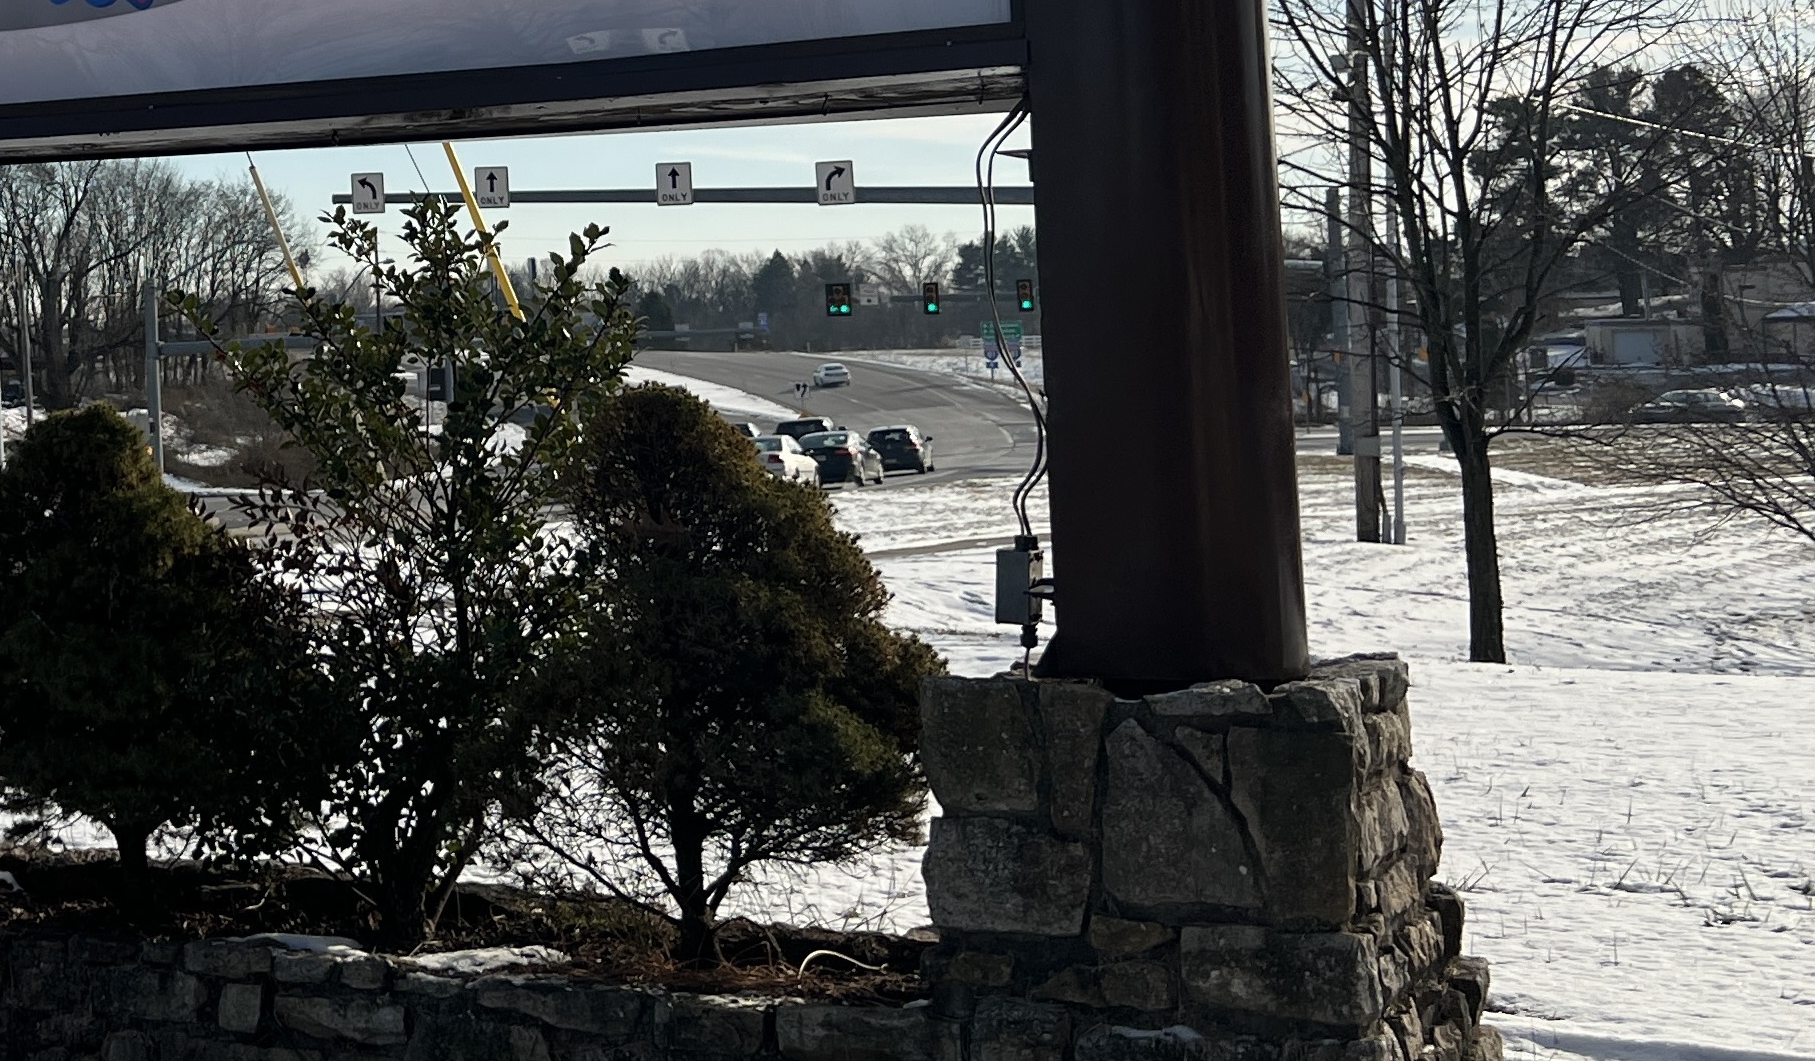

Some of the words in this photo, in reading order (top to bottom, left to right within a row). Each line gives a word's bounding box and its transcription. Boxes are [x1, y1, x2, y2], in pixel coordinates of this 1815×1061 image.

[480, 196, 505, 205] ONLY
[662, 193, 688, 202] ONLY
[823, 192, 850, 202] ONLY
[356, 202, 380, 211] ONLY
